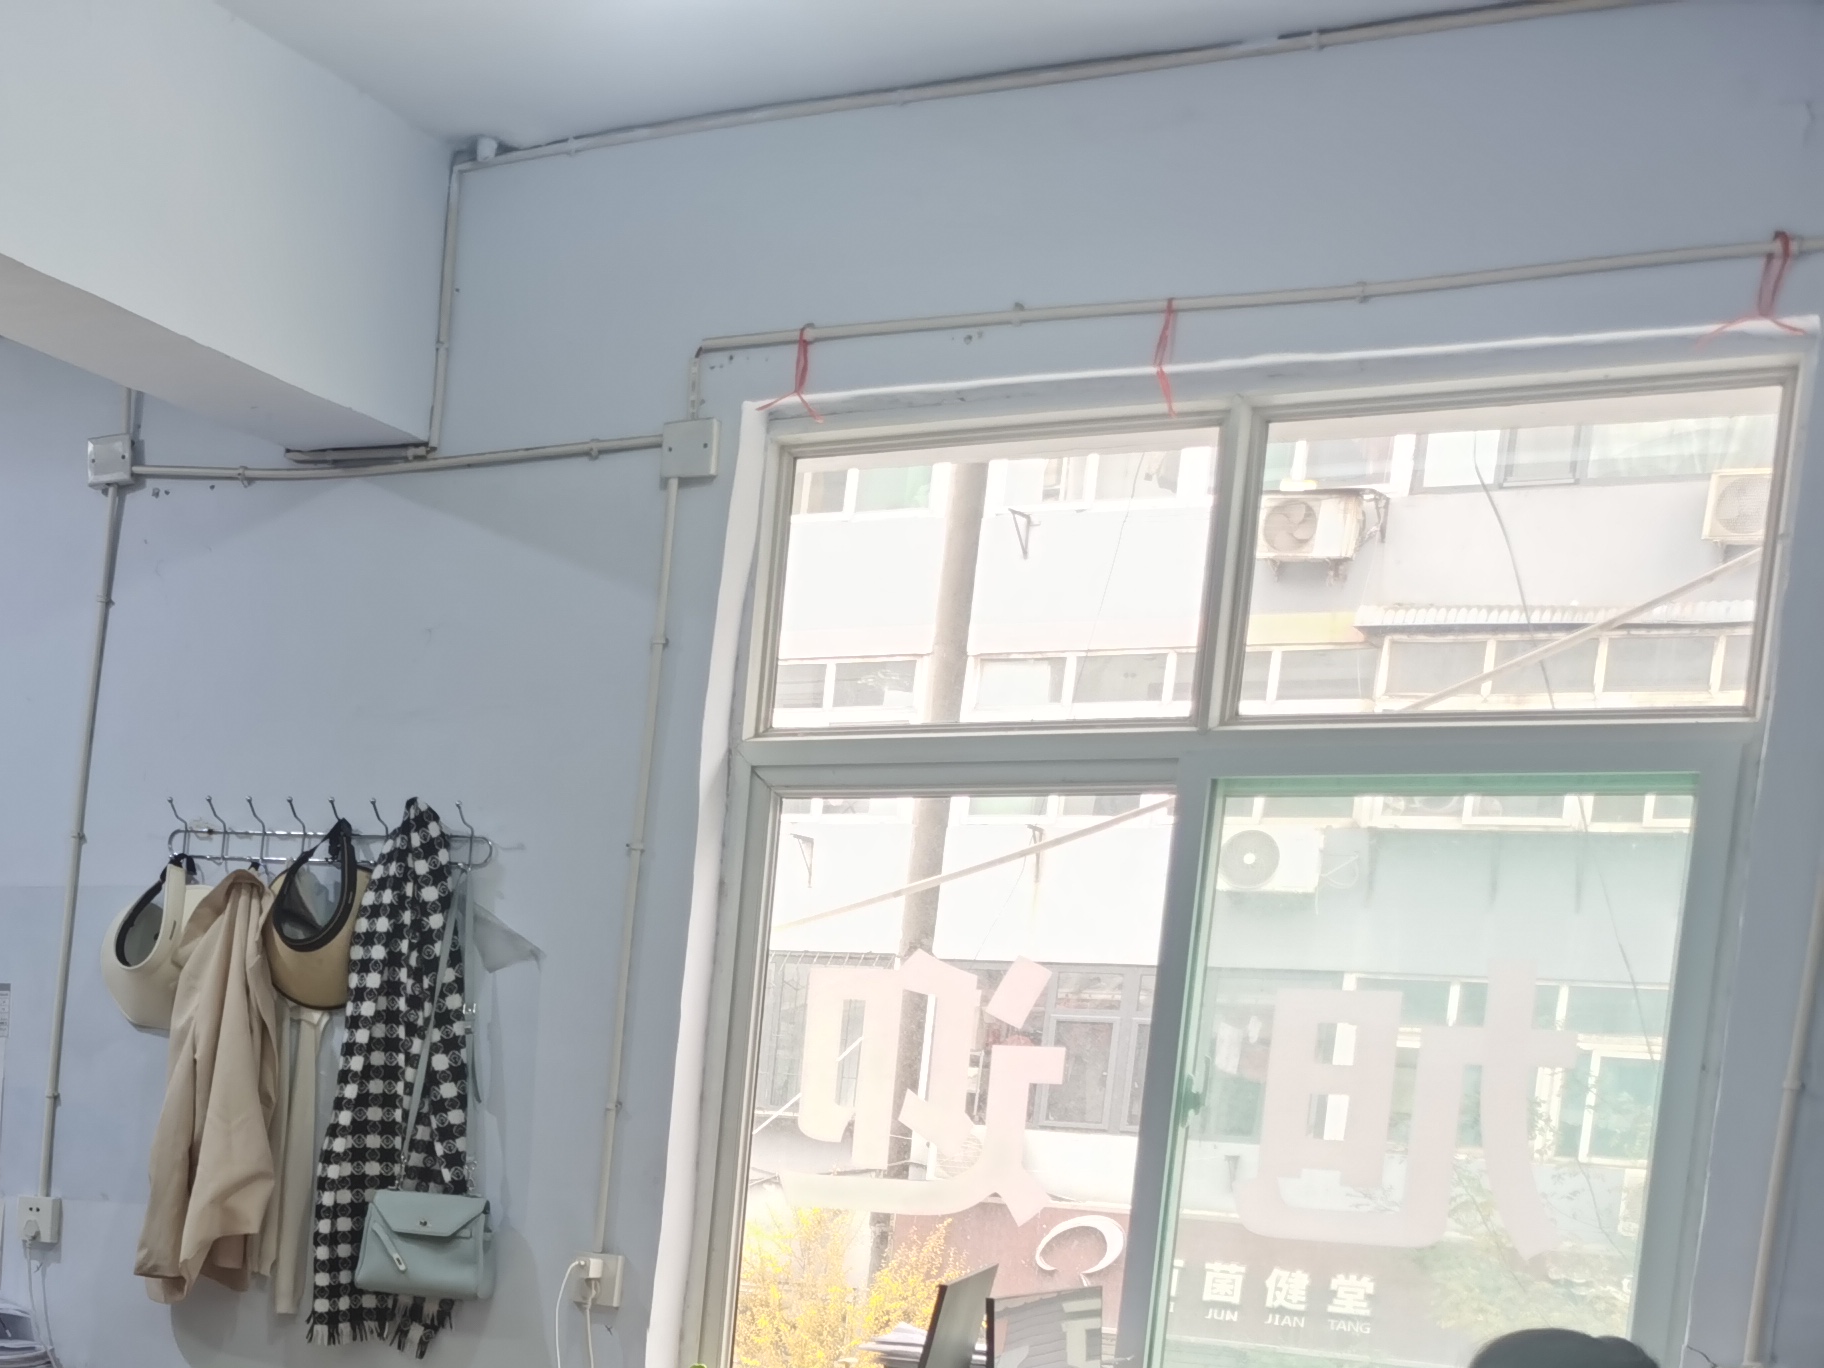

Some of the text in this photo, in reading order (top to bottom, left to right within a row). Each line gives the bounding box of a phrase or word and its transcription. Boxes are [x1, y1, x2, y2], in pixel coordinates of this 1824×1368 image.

[1204, 1308, 1372, 1335] JUN JIAN TANG
